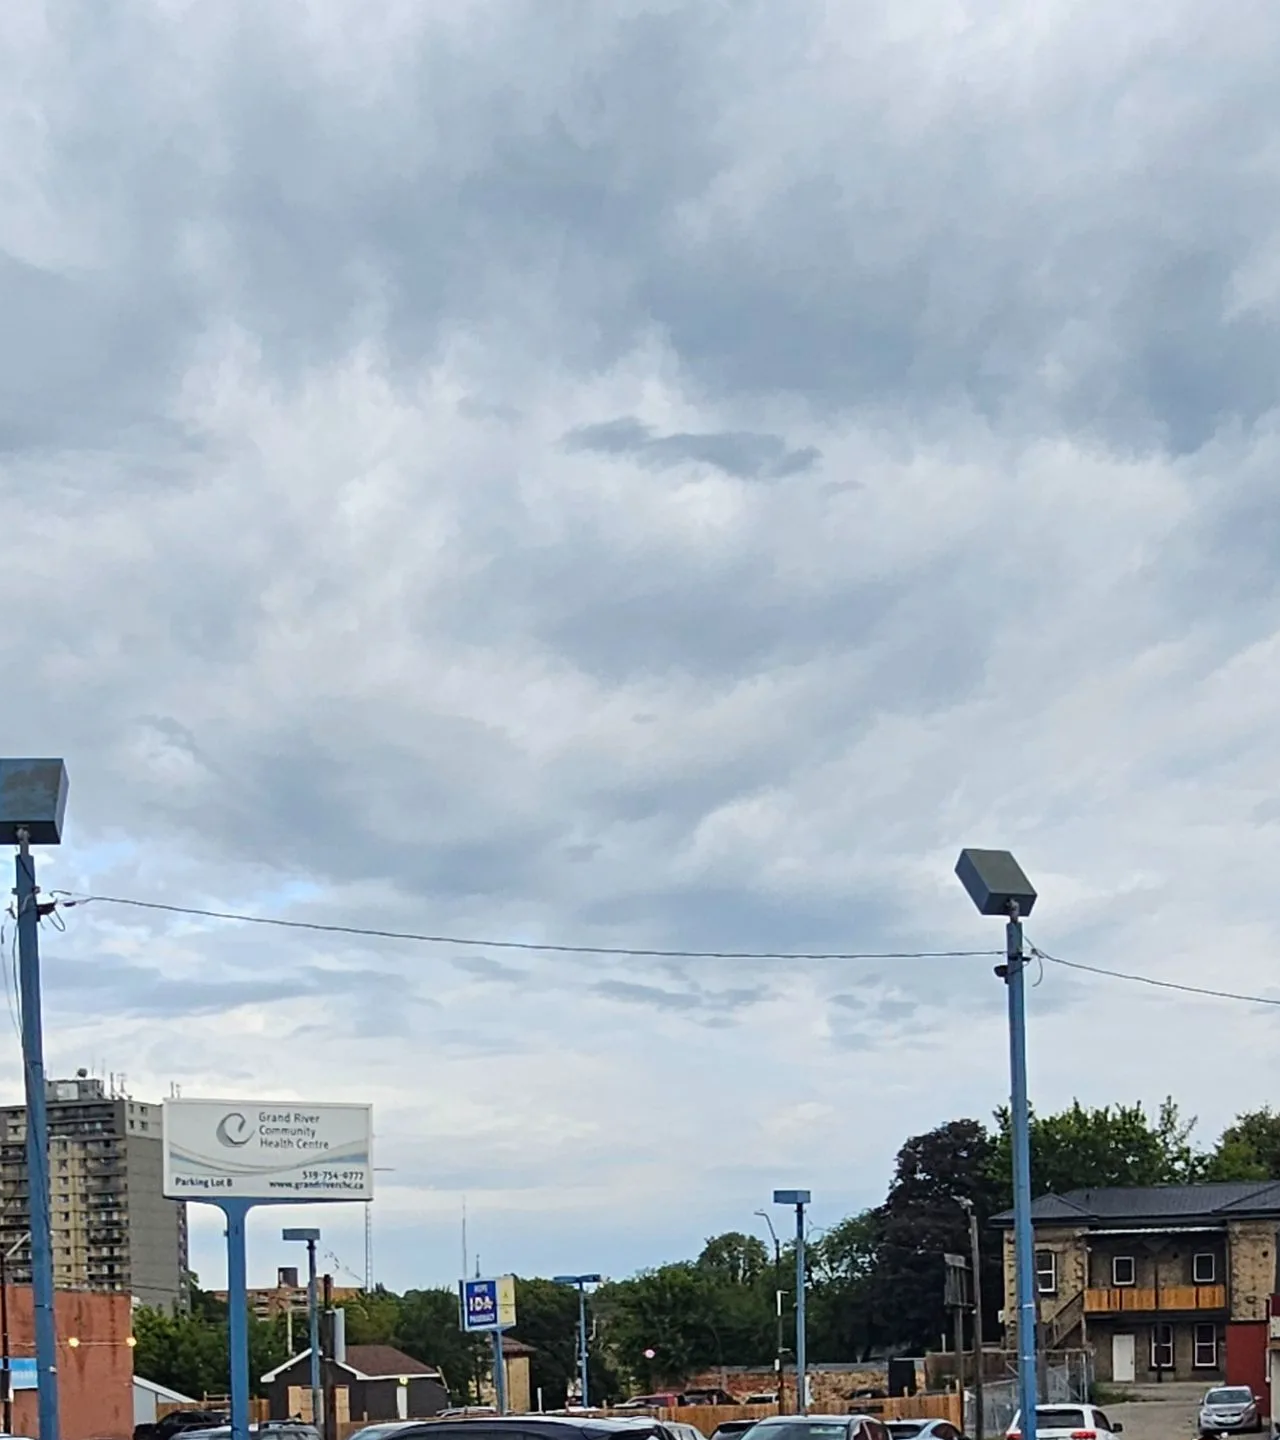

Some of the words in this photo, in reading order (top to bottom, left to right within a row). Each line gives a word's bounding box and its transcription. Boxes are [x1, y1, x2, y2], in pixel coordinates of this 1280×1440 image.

[258, 1112, 291, 1123] Grand
[294, 1113, 320, 1124] River
[259, 1125, 316, 1139] Community
[260, 1138, 294, 1149] Health
[296, 1138, 329, 1150] Centre
[175, 1177, 209, 1189] Parking
[211, 1178, 225, 1188] Lot
